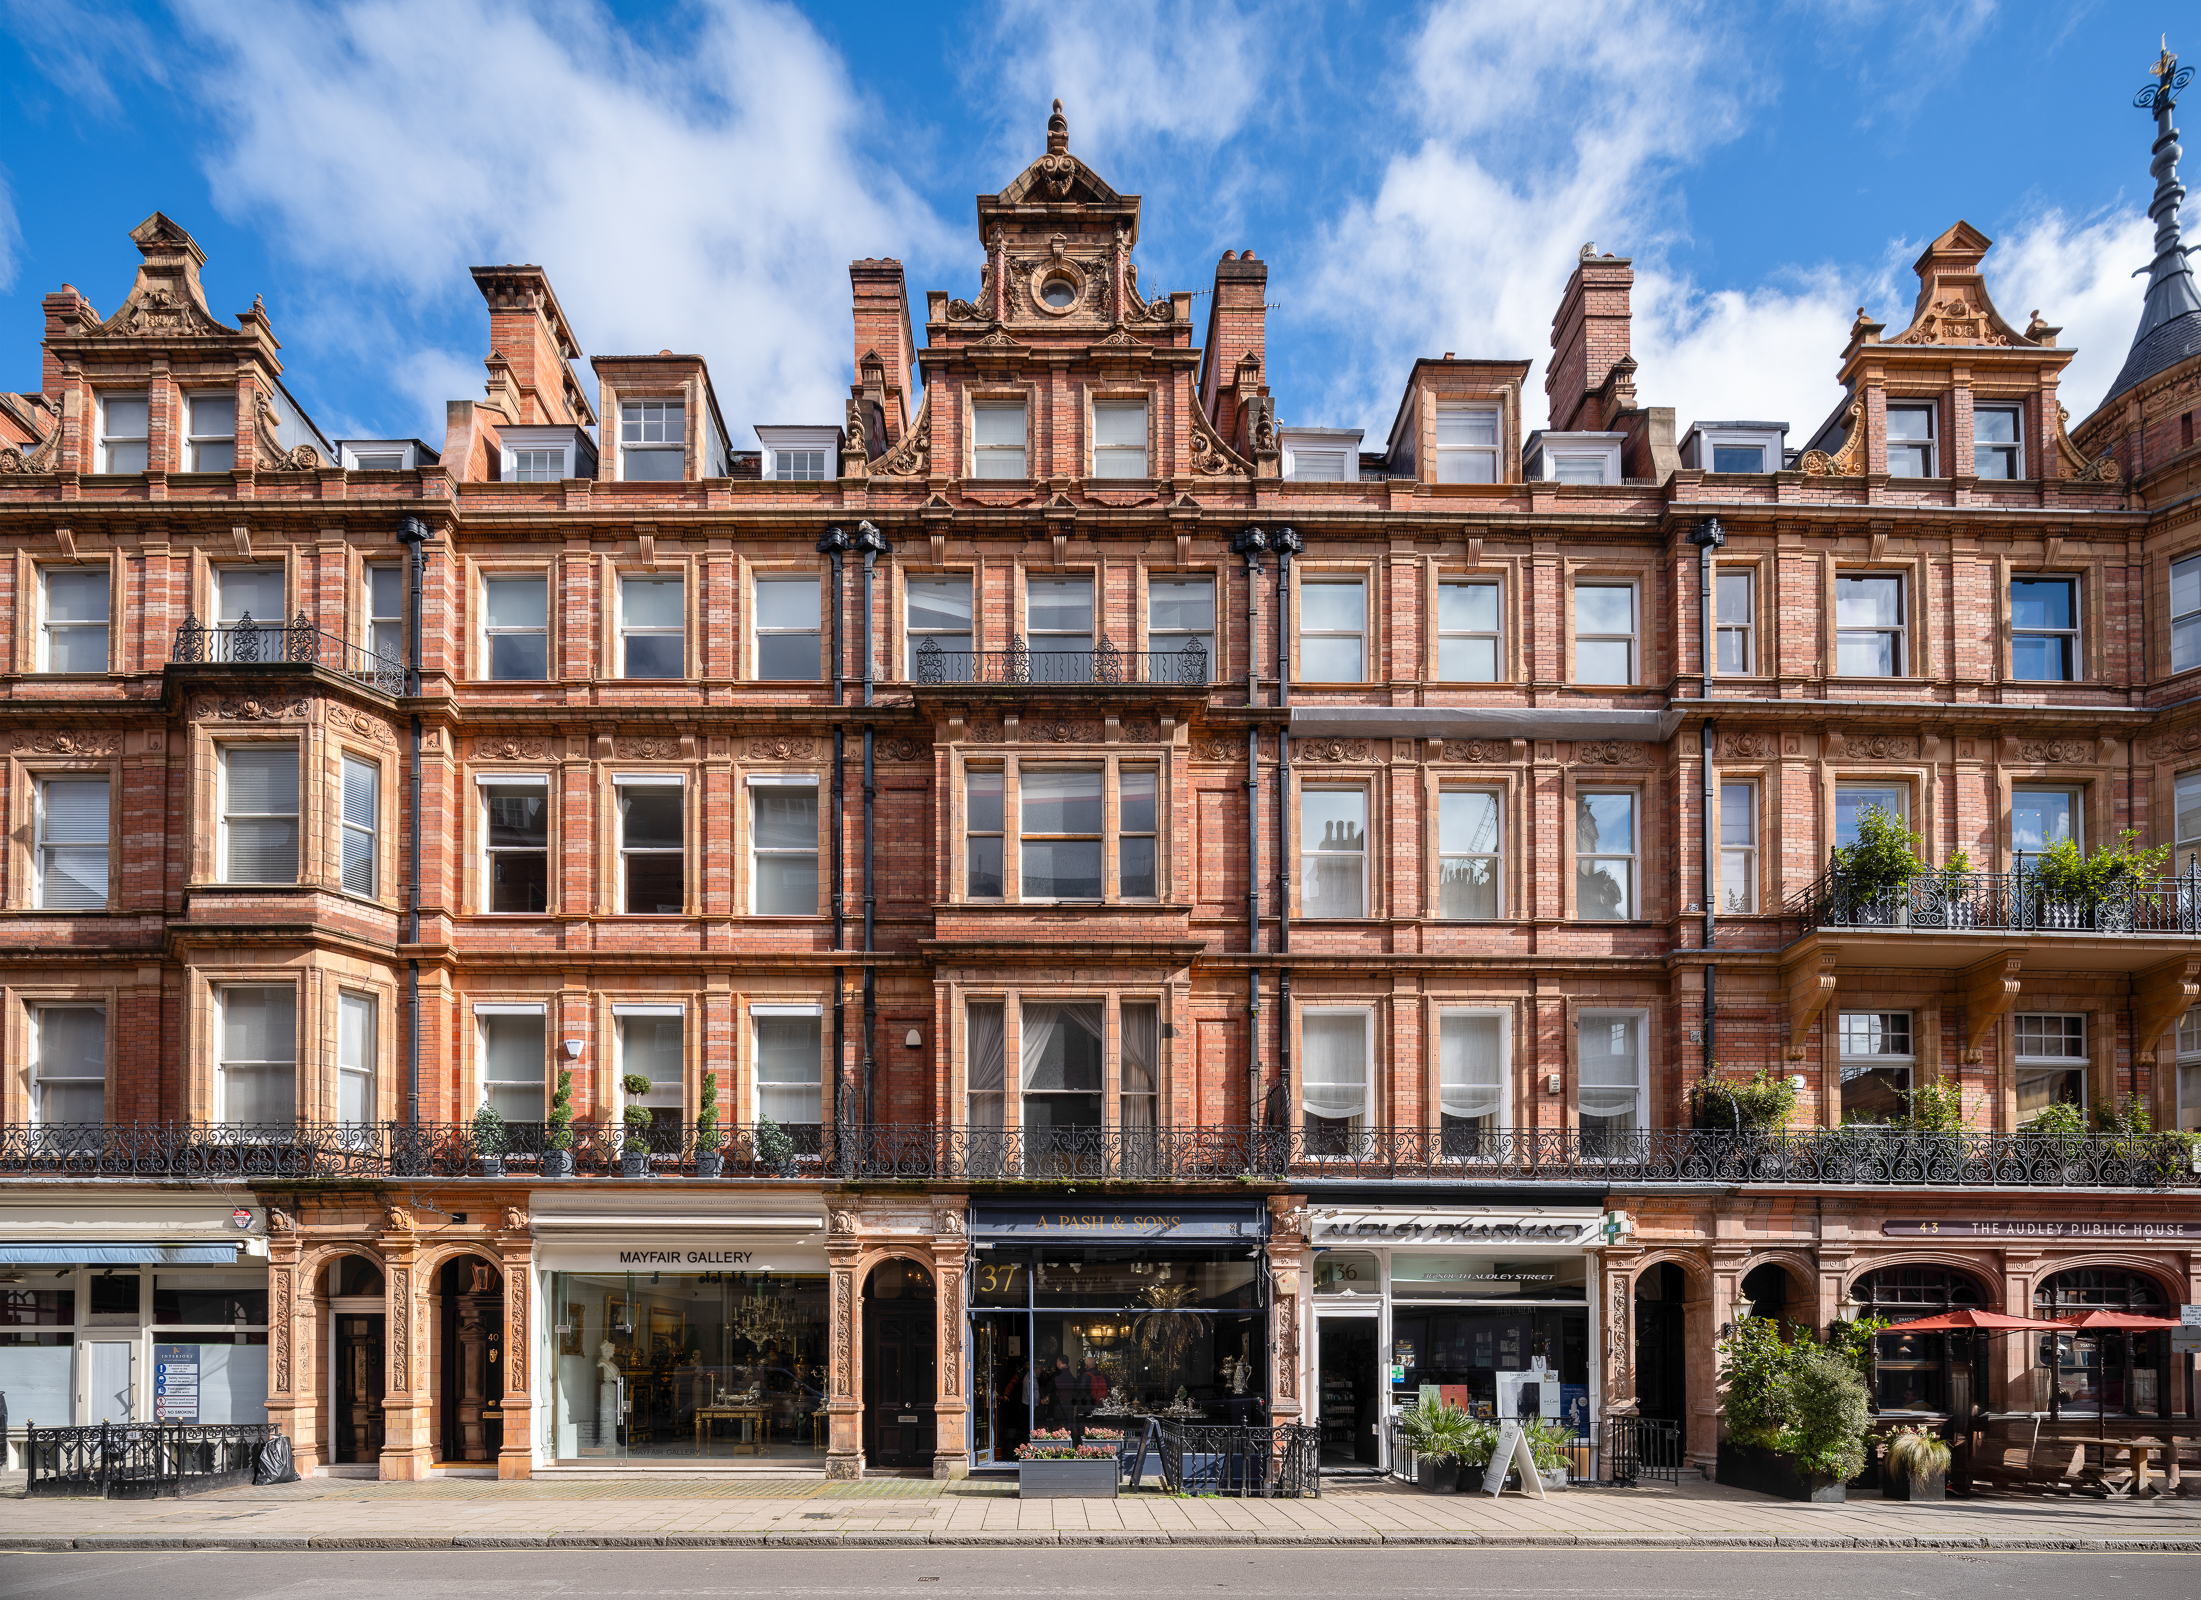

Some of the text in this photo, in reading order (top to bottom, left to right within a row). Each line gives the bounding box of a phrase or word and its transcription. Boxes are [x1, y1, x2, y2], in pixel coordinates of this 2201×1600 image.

[1036, 1215, 1181, 1231] A. PASH & SONS
[1319, 1223, 1593, 1237] AUDLEY PHARMACY
[1919, 1222, 1939, 1234] 43
[1972, 1222, 2184, 1236] THE AUDLEY PUBLIC HOUSE
[620, 1251, 753, 1263] MAYFAIR GALLERY
[980, 1264, 1015, 1292] 37
[1336, 1263, 1358, 1281] 36
[488, 1333, 499, 1341] 40
[631, 1448, 700, 1456] MAYFAIR GALLERY
